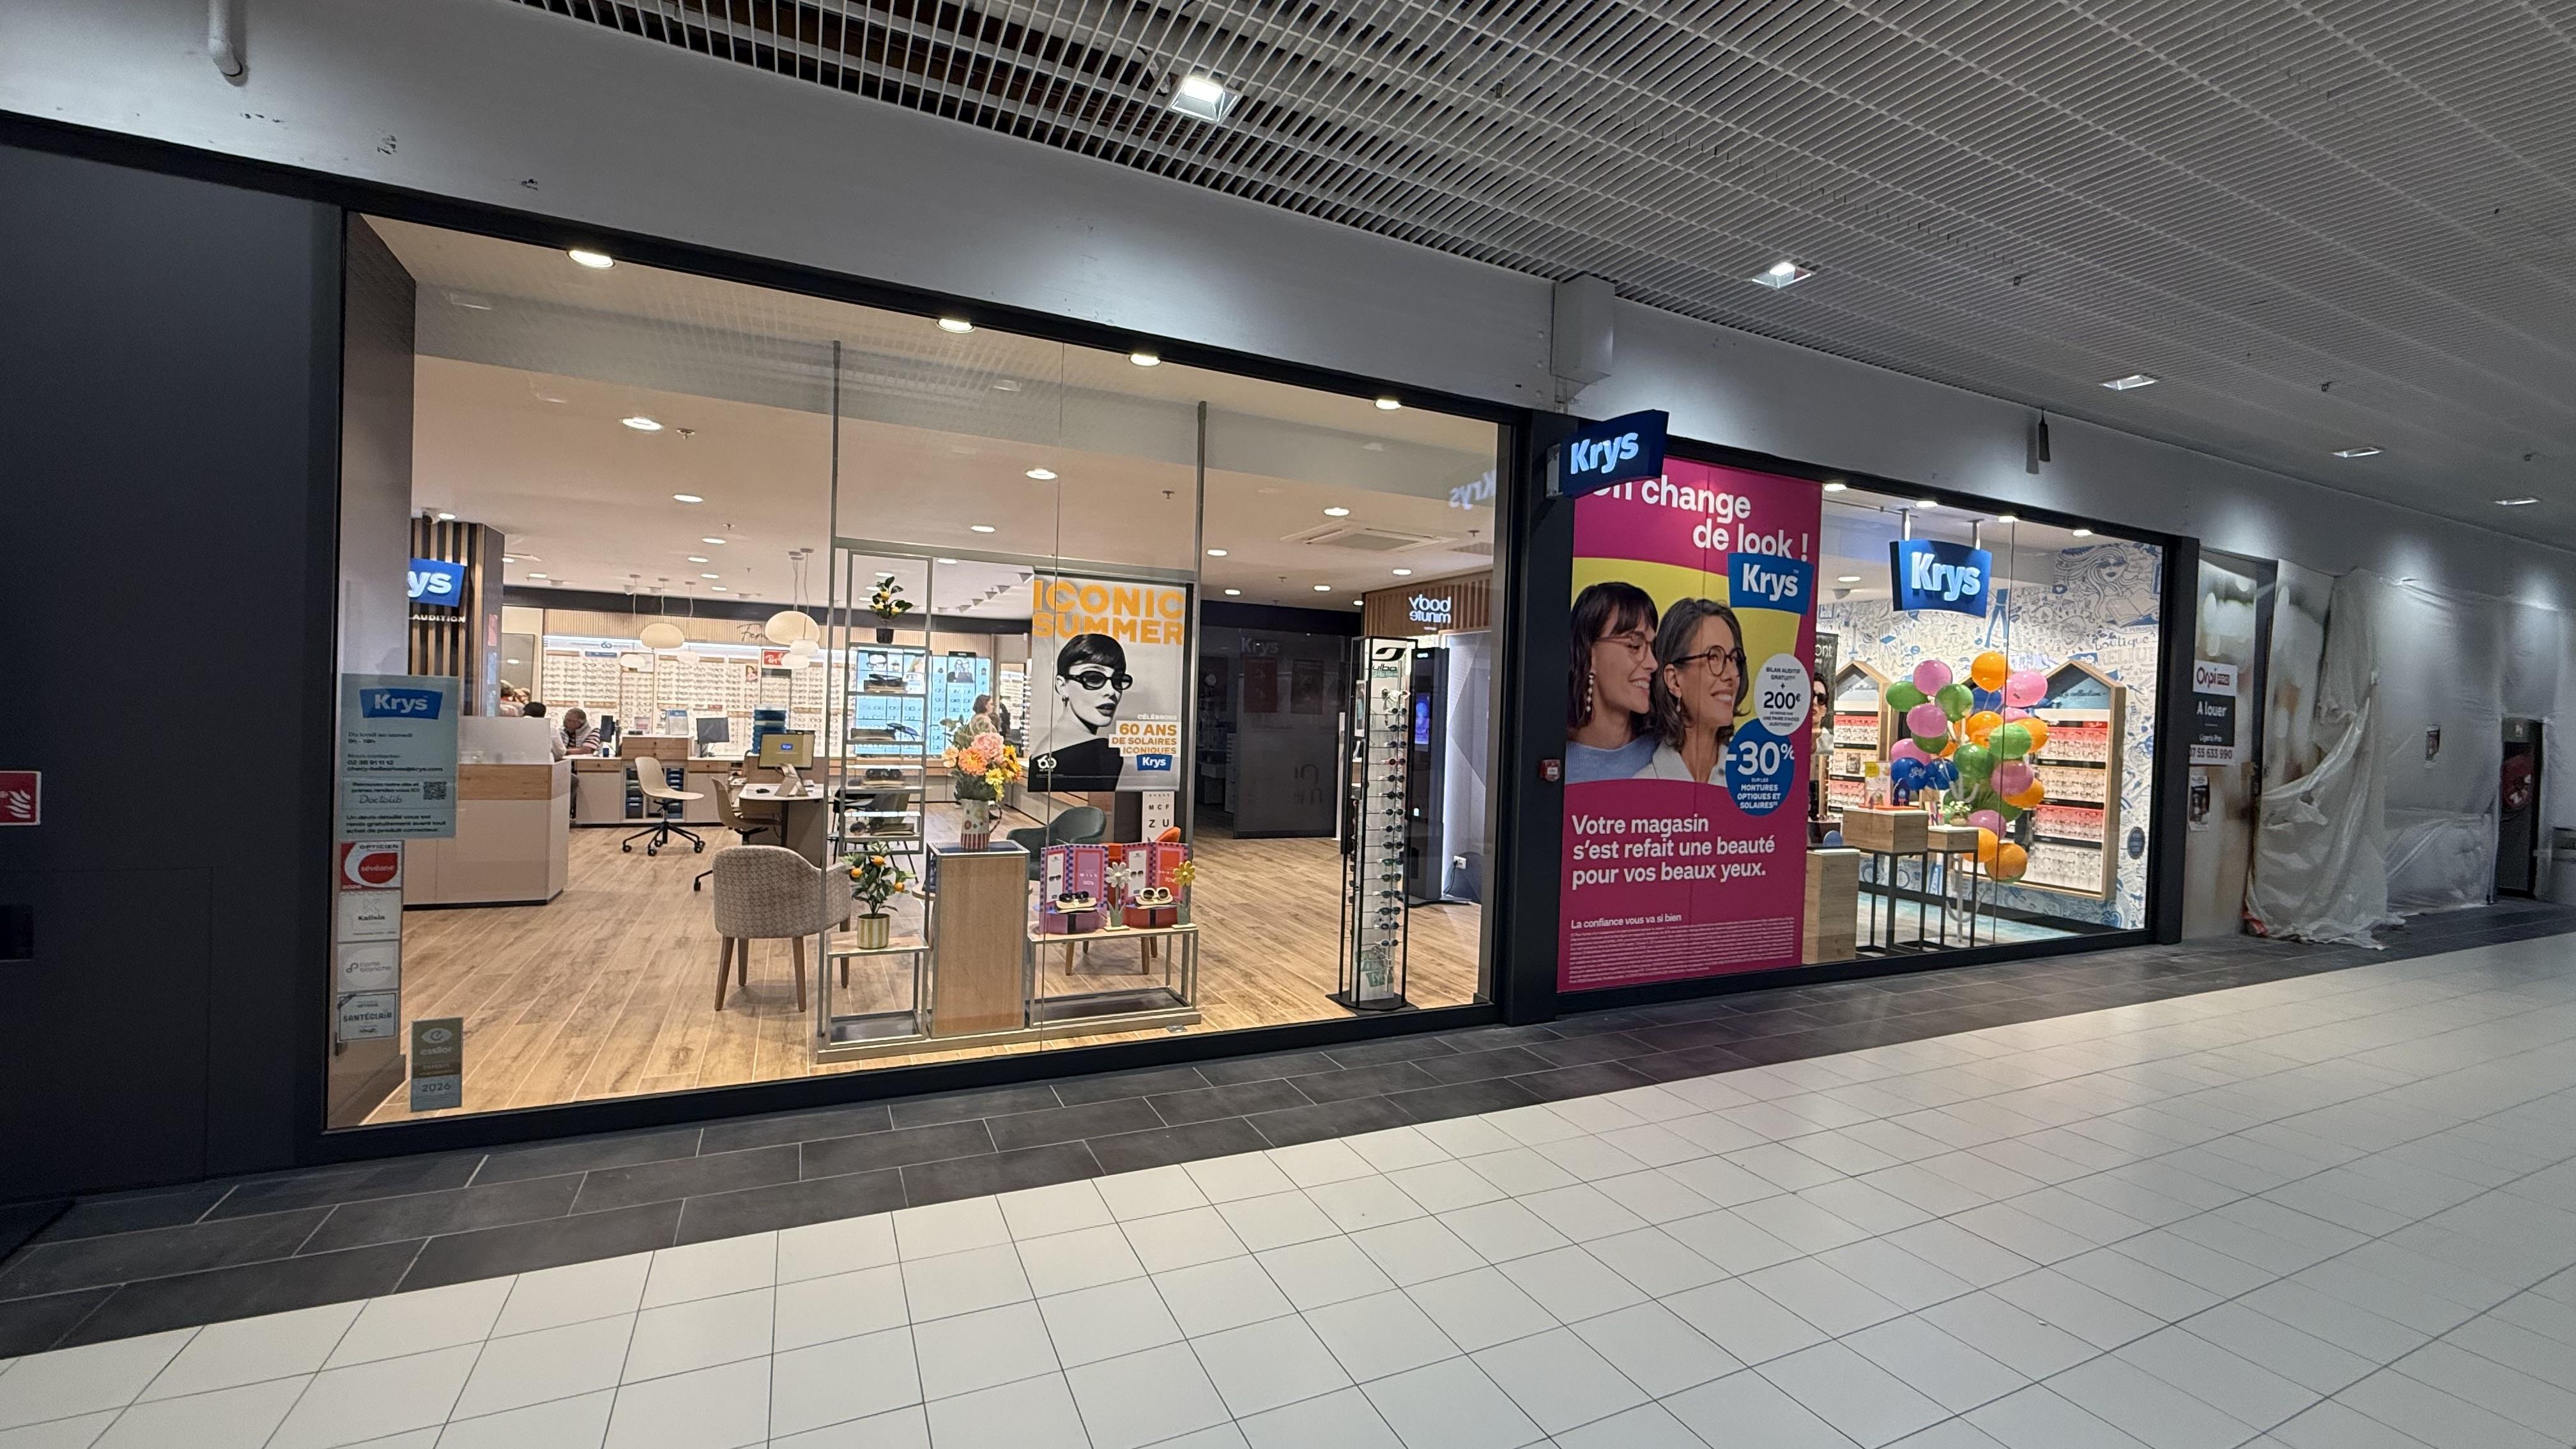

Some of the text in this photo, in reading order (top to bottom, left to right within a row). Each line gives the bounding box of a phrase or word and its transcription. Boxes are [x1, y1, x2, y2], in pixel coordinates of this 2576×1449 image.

[1570, 432, 1639, 474] Krys
[1593, 475, 1751, 524] n change
[1693, 518, 1808, 562] de look !
[407, 571, 452, 597] ys
[1742, 563, 1798, 601] Krys
[1912, 551, 1981, 601] Krys
[1032, 579, 1186, 619] ICONIC
[737, 623, 767, 642] Fem
[1032, 611, 1183, 645] SUMMER
[2196, 666, 2229, 688] Orpi PRO
[374, 693, 427, 713] Krys
[1763, 691, 1801, 709] 200€
[2196, 701, 2227, 717] A louer
[1119, 723, 1177, 736] 60 ANS
[1128, 737, 1177, 746] SOLAIRES
[1142, 756, 1167, 769] Krys
[1726, 741, 1795, 775] -30%
[2206, 748, 2218, 758] 633
[2220, 749, 2232, 759] 990
[359, 794, 402, 804] Doctolib
[1149, 818, 1169, 828] Z U
[1572, 813, 1708, 838] Votre magasin
[1573, 835, 1775, 860] s'est refait une beauté
[1572, 862, 1766, 890] pour vos beaux yeux.
[1571, 919, 1582, 929] La
[1583, 917, 1623, 928] confiance
[1625, 916, 1644, 924] vous
[1657, 914, 1664, 922] si
[1664, 913, 1682, 923] bien
[420, 1046, 451, 1055] essilor
[422, 1083, 451, 1092] 2026
